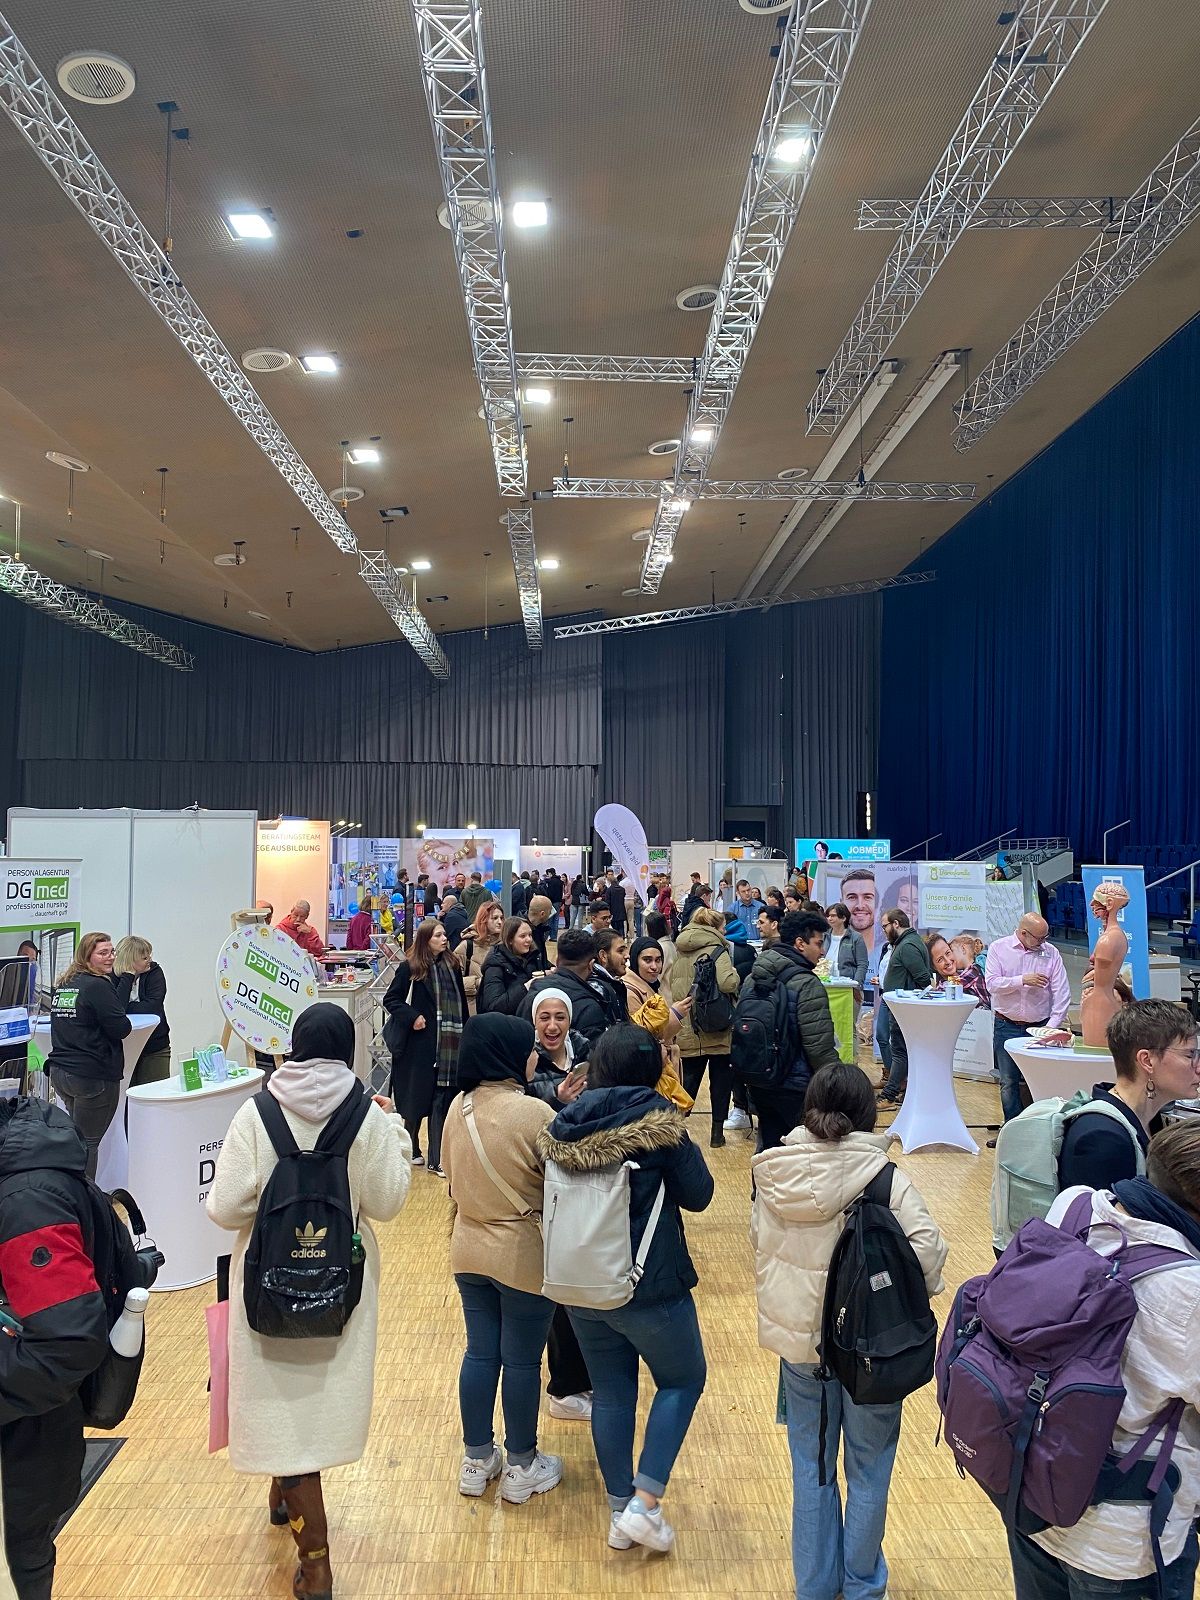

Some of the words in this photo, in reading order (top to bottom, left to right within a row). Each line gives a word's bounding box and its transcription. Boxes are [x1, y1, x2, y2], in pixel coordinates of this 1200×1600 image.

[7, 869, 70, 877] PERSONALAGENTUR
[6, 881, 32, 900] DG
[36, 880, 67, 899] med
[5, 902, 46, 912] professional
[46, 901, 68, 909] nursing
[247, 953, 277, 976] med
[278, 971, 300, 994] DG
[234, 998, 269, 1020] professional
[236, 981, 260, 1005] DG
[261, 1000, 290, 1023] med
[290, 1248, 327, 1259] adidas
